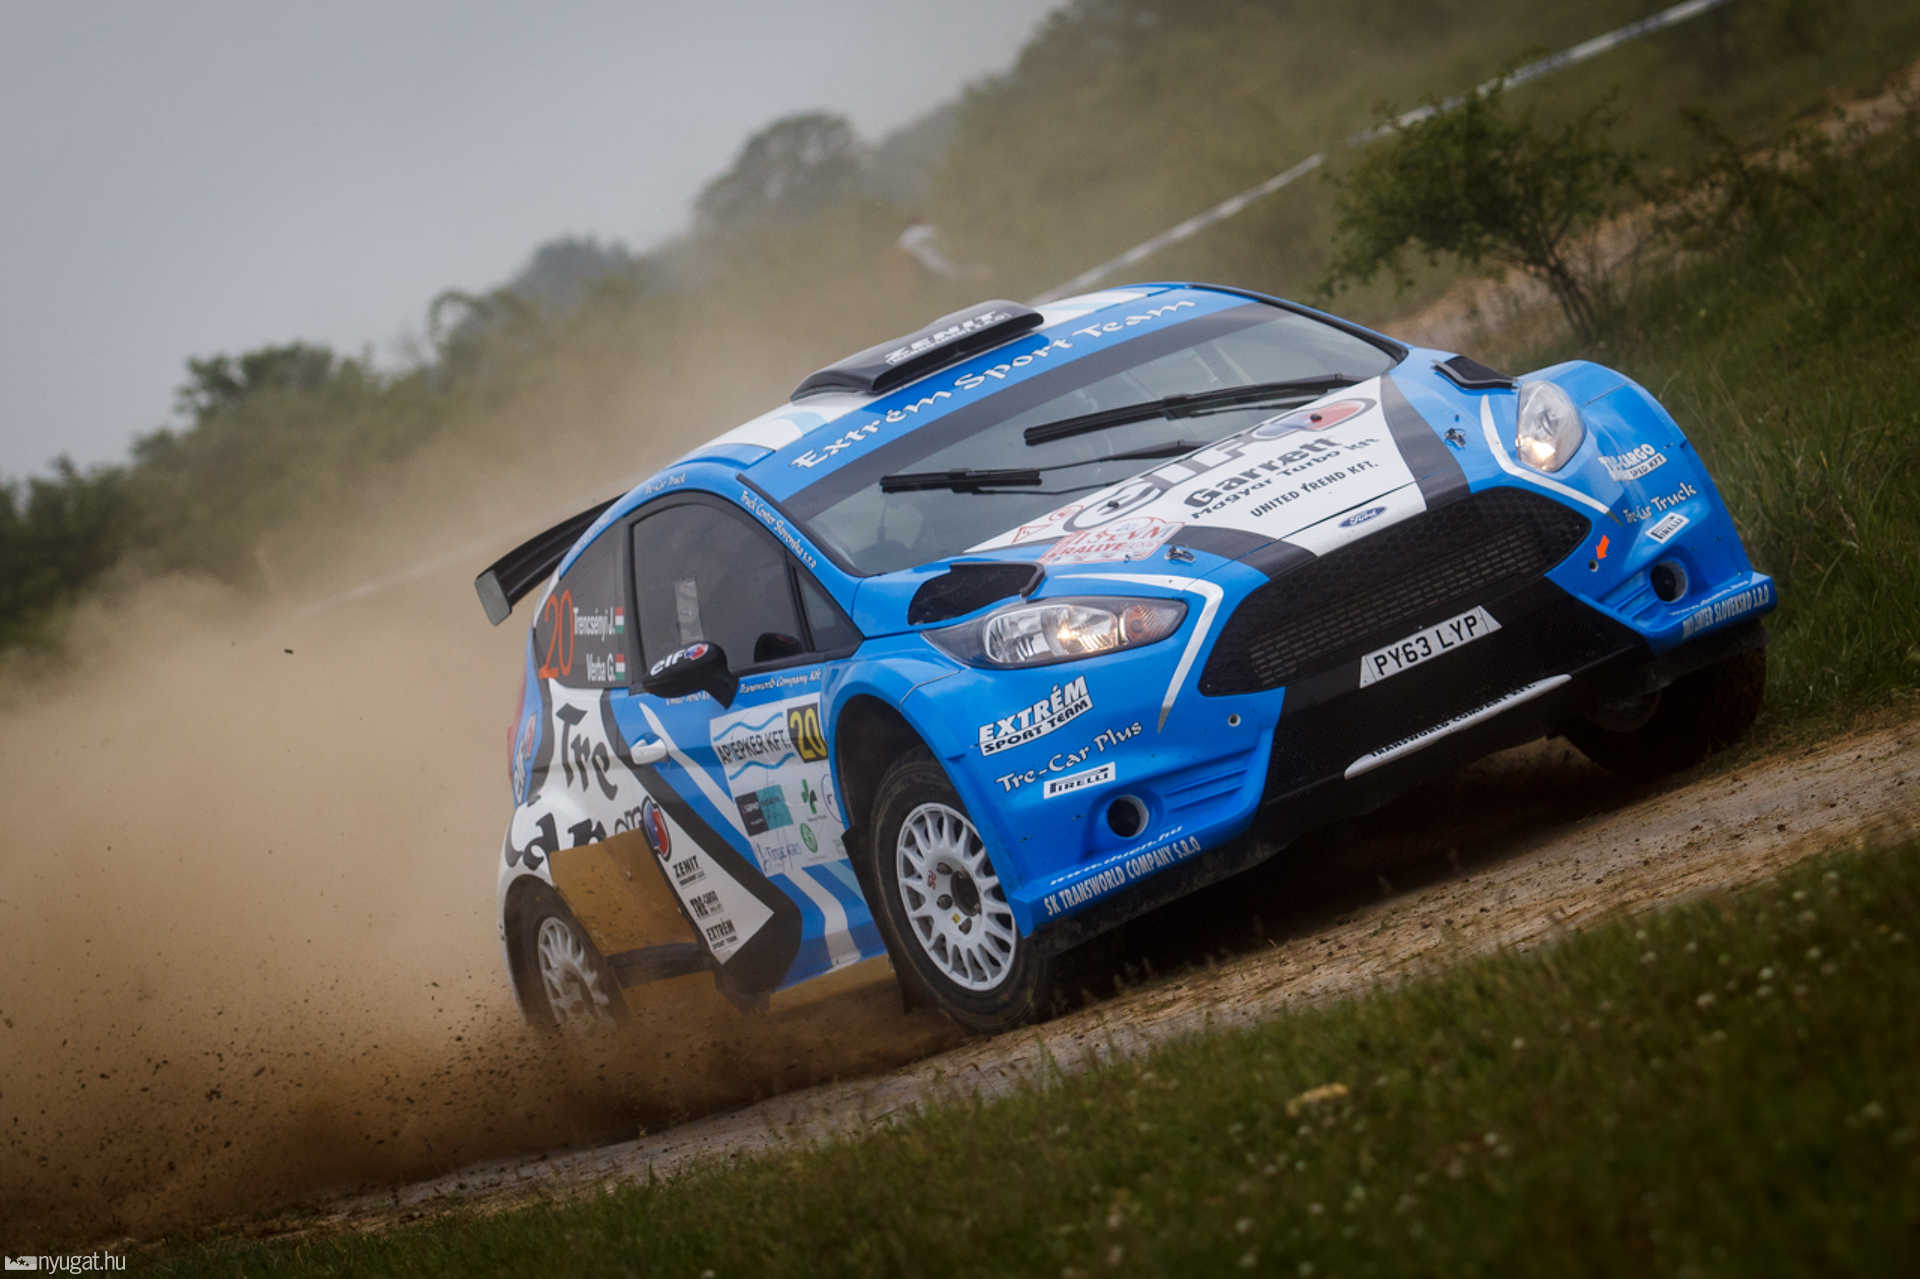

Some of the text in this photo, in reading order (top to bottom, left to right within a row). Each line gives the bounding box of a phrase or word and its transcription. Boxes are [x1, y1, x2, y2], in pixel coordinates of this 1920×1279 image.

[790, 388, 952, 469] Extrém
[954, 338, 1073, 391] Sport
[1070, 299, 1196, 339] Team
[1184, 436, 1343, 507] Garrett
[1191, 479, 1273, 520] Magyar
[1275, 450, 1342, 477] Turbo
[1250, 459, 1379, 518] UNITED TREND KFT.
[1650, 481, 1697, 512] Truck
[539, 588, 575, 681] 20
[1374, 615, 1478, 676] PY63 LYP
[789, 706, 828, 761] 20
[979, 675, 1089, 743] EXTRÉM
[984, 699, 1089, 753] SPORT TEAM
[555, 702, 619, 801] Tre
[994, 721, 1143, 793] Tre-Car Plus
[1049, 767, 1110, 795] PIRELLI
[1043, 894, 1062, 916] SK
[1059, 865, 1126, 910] TRANSWORLD
[1125, 844, 1176, 879] COMPANY
